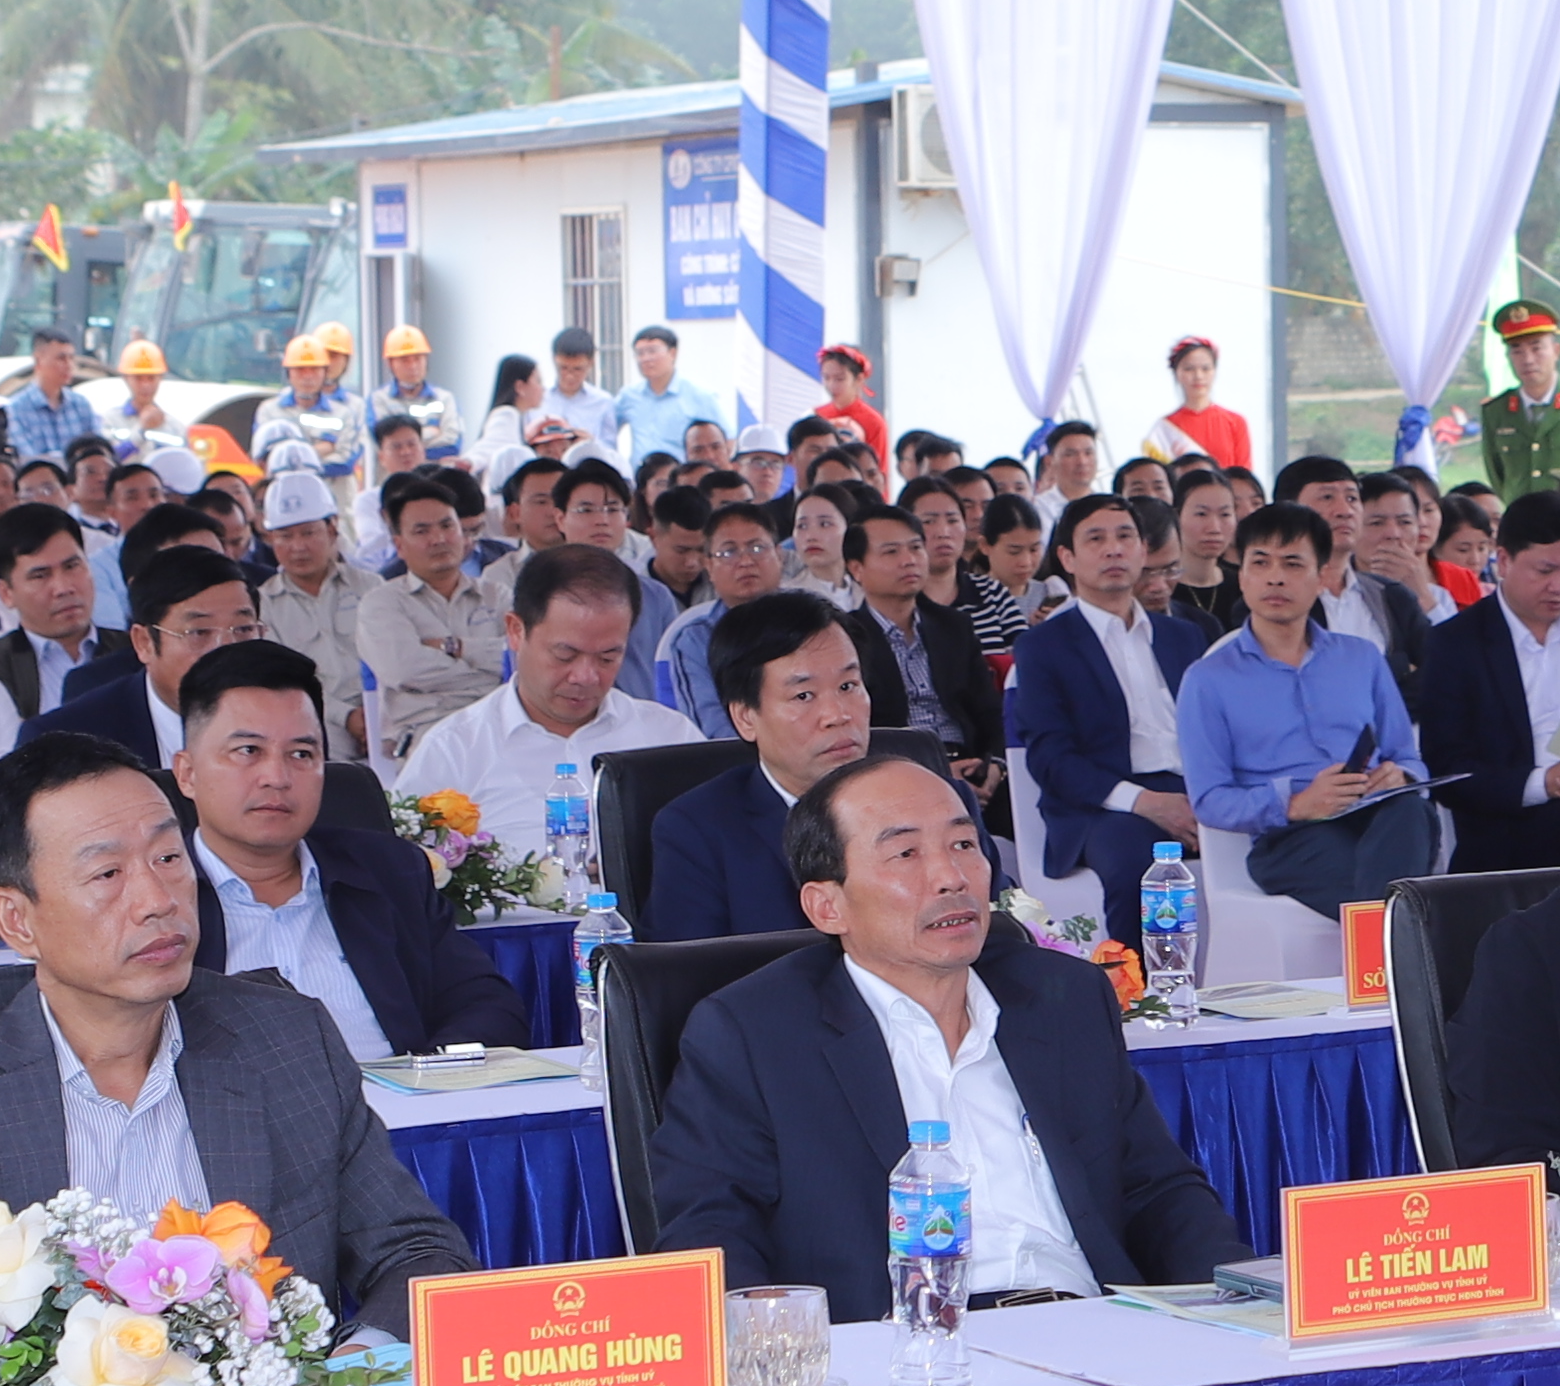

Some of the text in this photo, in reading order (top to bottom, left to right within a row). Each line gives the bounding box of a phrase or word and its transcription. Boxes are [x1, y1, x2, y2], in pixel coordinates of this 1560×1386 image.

[1383, 1224, 1451, 1246] ĐỒNG CHÍ
[1346, 1243, 1489, 1283] LÊ TIẾN LAM
[1363, 1285, 1382, 1298] VIÊN
[1383, 1285, 1402, 1296] BAN
[1404, 1280, 1439, 1294] THƯỜNG
[1442, 1279, 1453, 1291] VỤ
[1455, 1276, 1475, 1288] TỈNH
[1332, 1286, 1505, 1315] PHÓ CHỦ TỊCH THƯỜNG TRỰC HĐND TỈNH
[530, 1315, 611, 1340] ĐỒNG CHÍ
[462, 1332, 682, 1384] LÊ QUANG HÙNG
[615, 1372, 640, 1385] TỈNH
